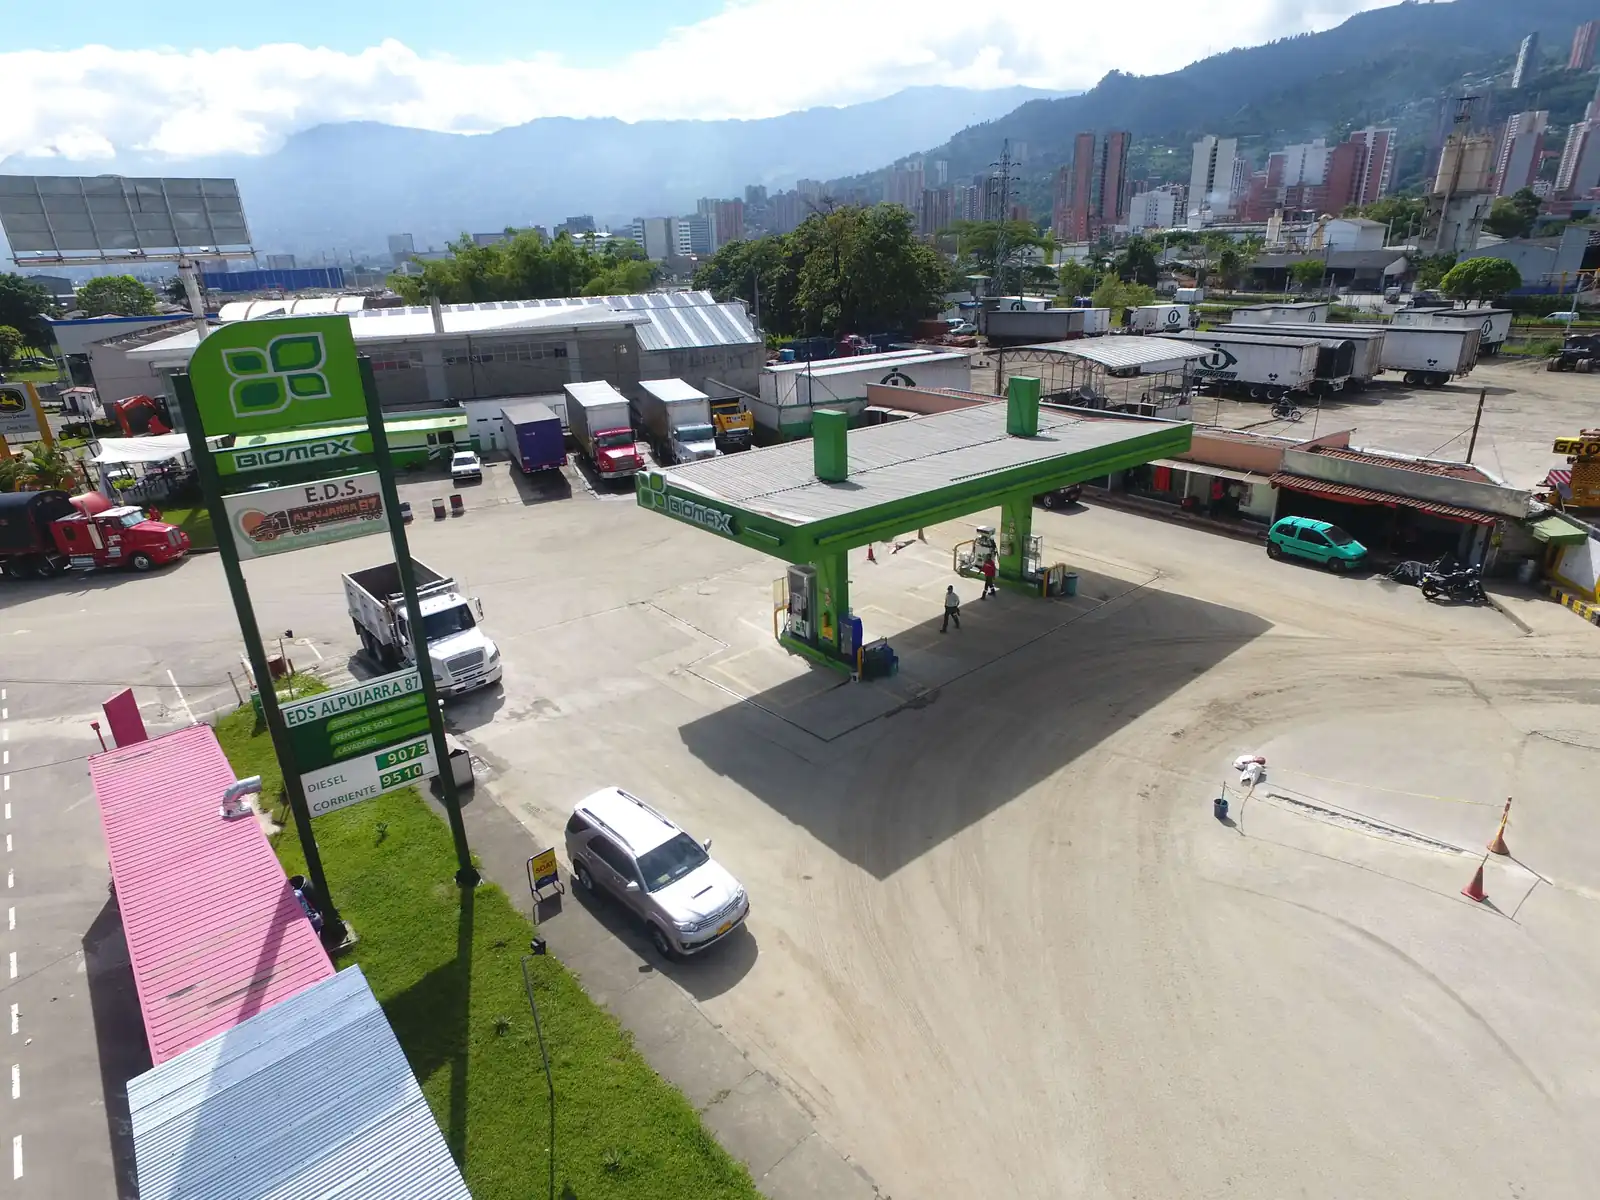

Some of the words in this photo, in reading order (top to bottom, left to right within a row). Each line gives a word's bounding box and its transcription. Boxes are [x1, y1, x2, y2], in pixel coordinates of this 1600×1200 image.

[233, 438, 361, 471] BIOMAX
[305, 480, 363, 503] E.D.S.
[668, 495, 734, 536] BIOMAX
[287, 706, 317, 726] EDS
[321, 683, 402, 717] ALPUJARRA
[405, 676, 419, 691] 87
[362, 726, 373, 734] DE
[308, 774, 347, 793] DIESEL
[388, 743, 428, 764] 9073
[313, 784, 377, 812] CORRIENTE
[382, 764, 422, 786] 9510
[536, 861, 553, 873] SOAT
